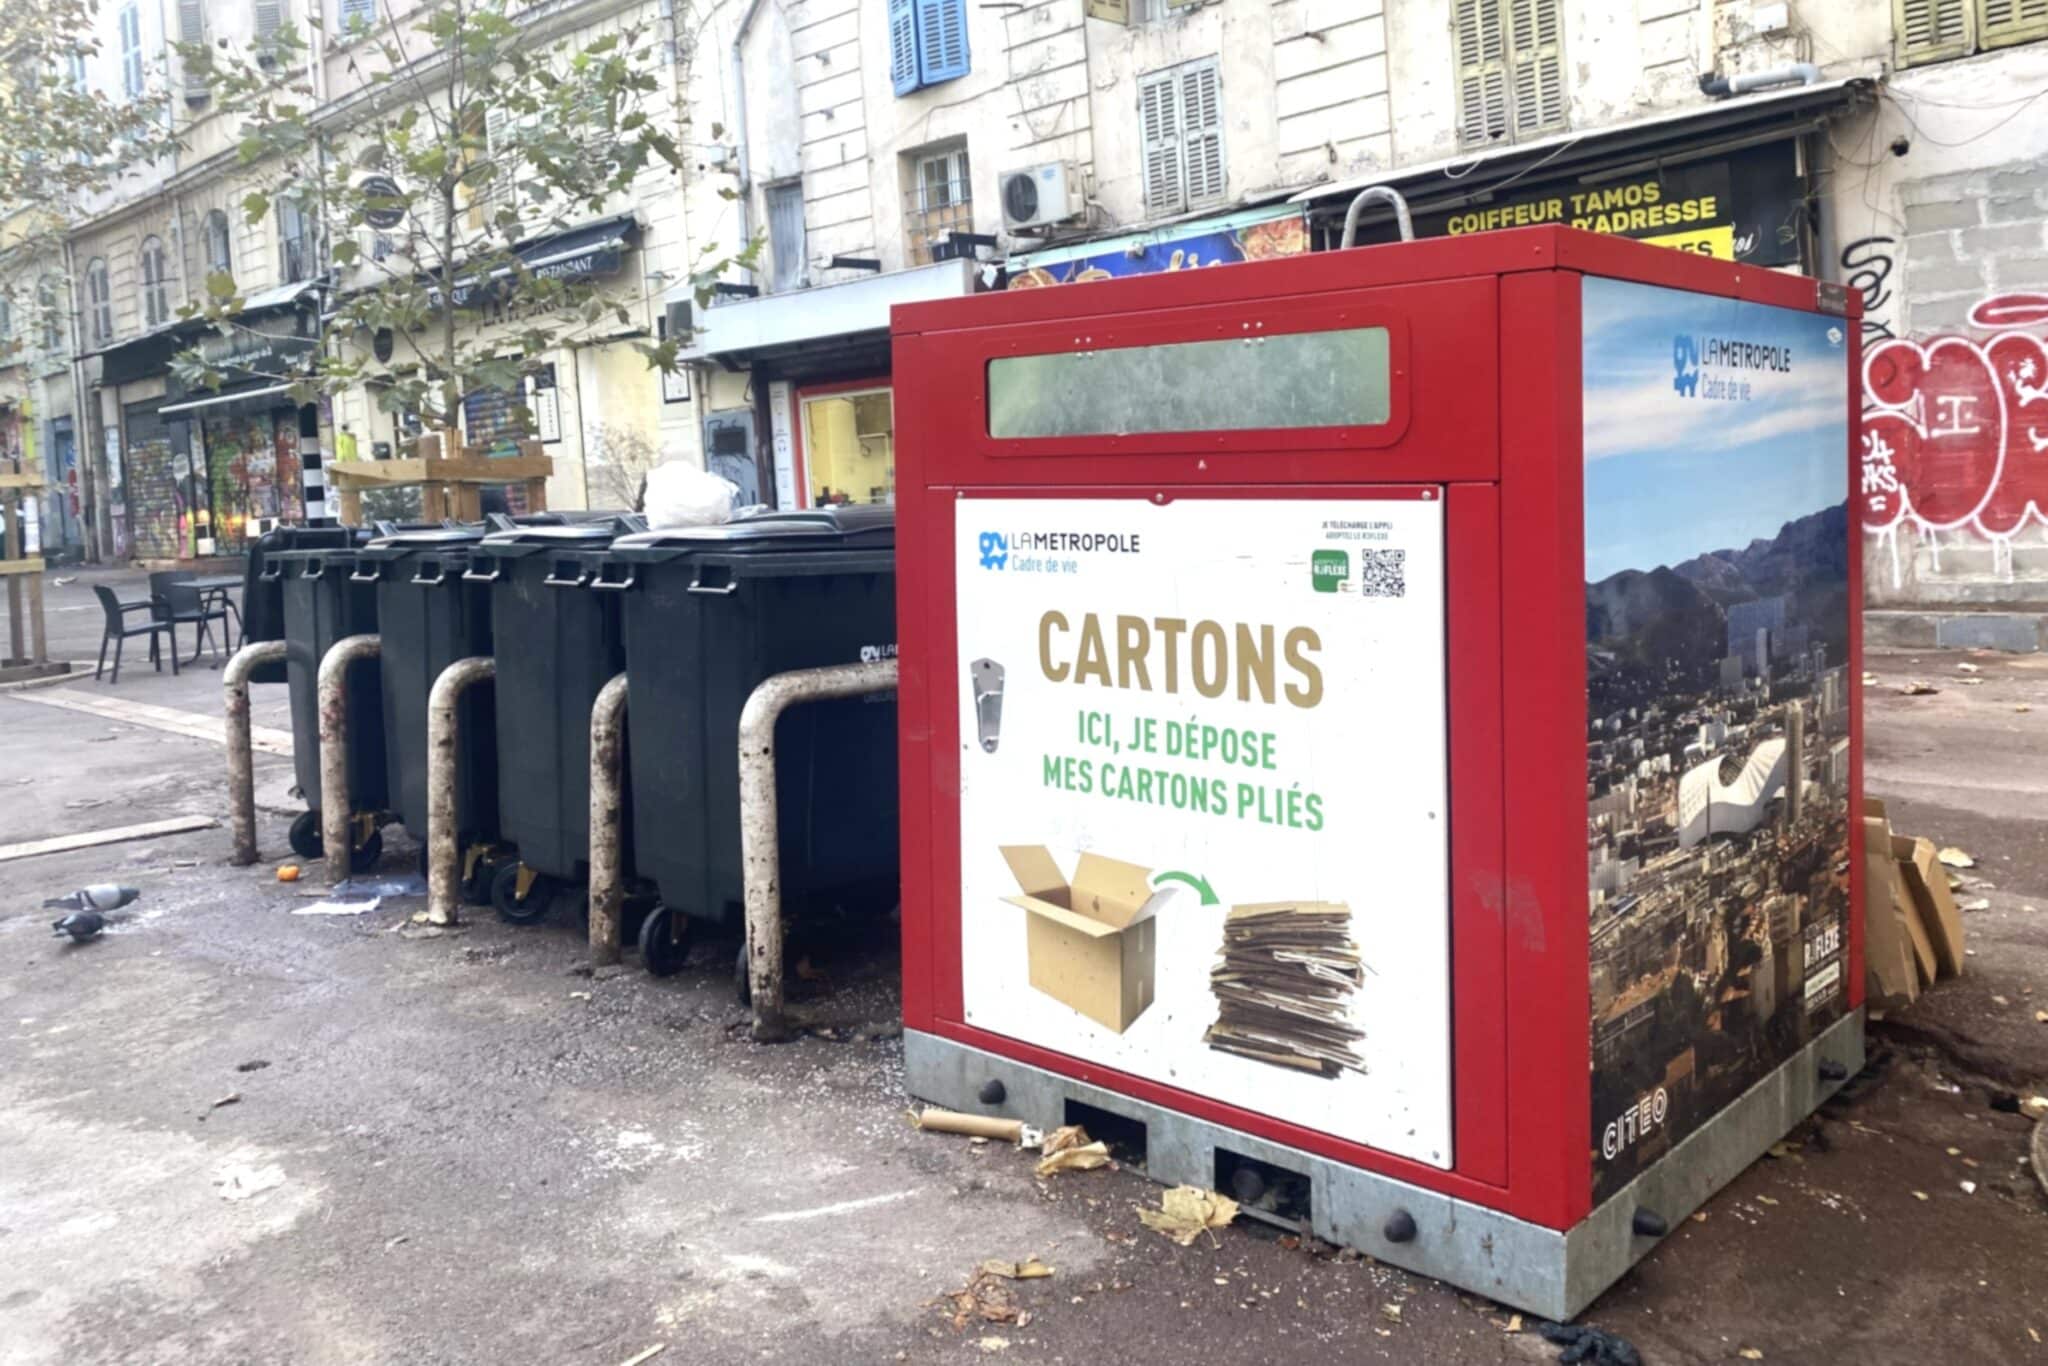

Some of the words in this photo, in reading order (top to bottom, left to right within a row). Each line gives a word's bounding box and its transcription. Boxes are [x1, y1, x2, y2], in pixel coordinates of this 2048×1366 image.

[1447, 199, 1563, 236] COIFFEUR
[1570, 182, 1661, 215] TAMOS
[1572, 197, 1717, 234] D'ADRESSE
[1702, 373, 1726, 400] Cadre
[1728, 376, 1737, 400] de
[1739, 378, 1751, 401] vie
[1011, 554, 1042, 572] Cadre
[1045, 556, 1059, 573] de
[1062, 557, 1078, 574] vie
[1038, 609, 1324, 709] CARTONS
[1078, 710, 1120, 755] ICI,
[1127, 716, 1157, 753] JE
[1166, 713, 1276, 770] DÉPOSE
[1043, 754, 1093, 793] MES
[1101, 762, 1227, 815] CARTONS
[1237, 781, 1324, 831] PLIÉS
[1602, 1087, 1668, 1161] CITEO
